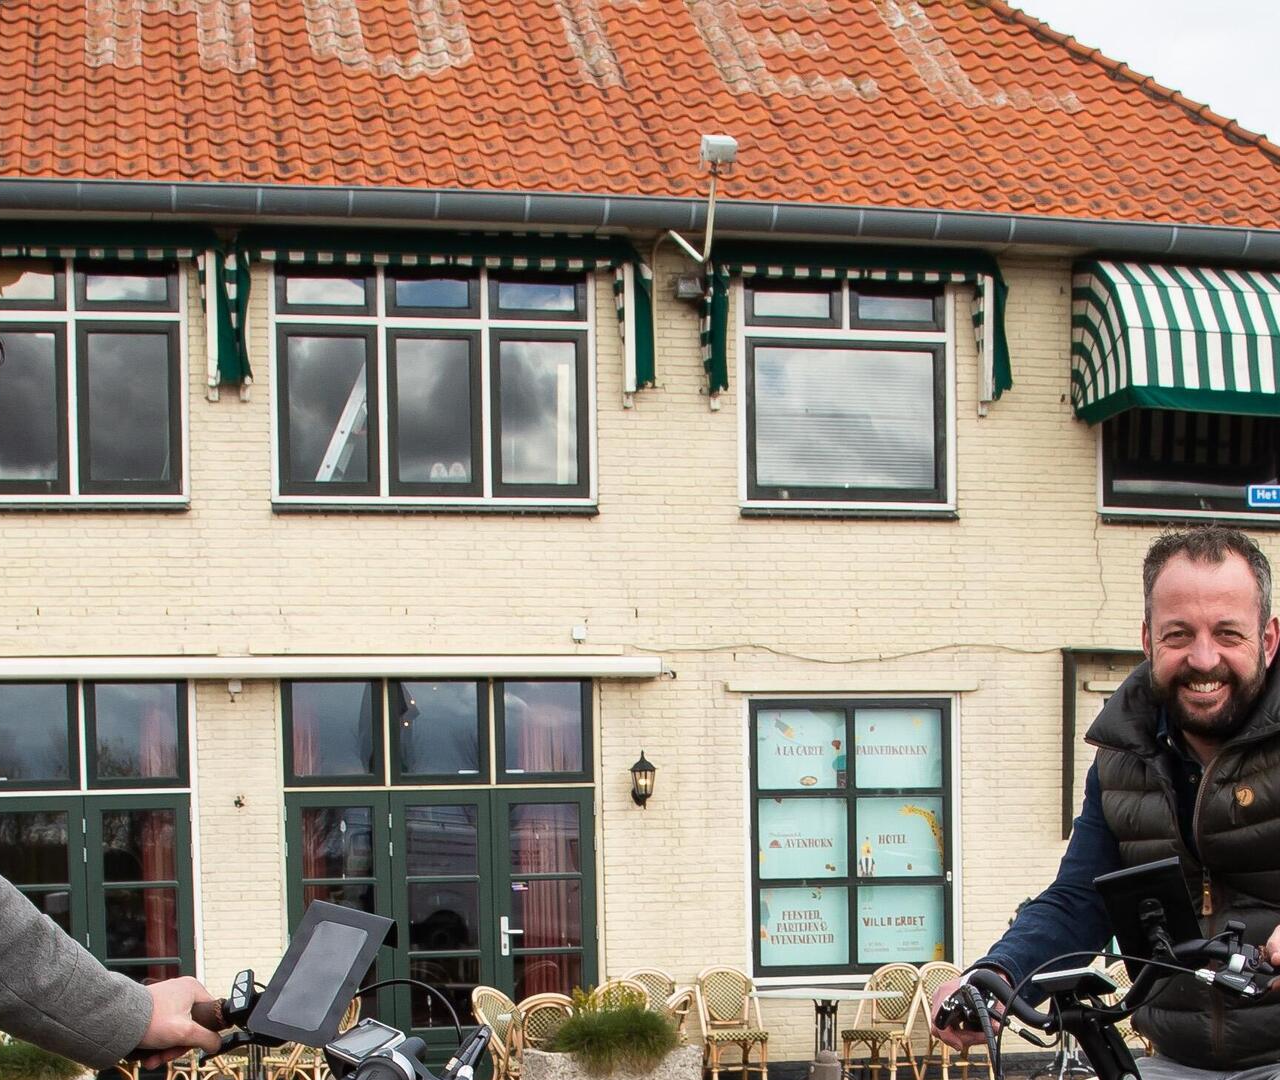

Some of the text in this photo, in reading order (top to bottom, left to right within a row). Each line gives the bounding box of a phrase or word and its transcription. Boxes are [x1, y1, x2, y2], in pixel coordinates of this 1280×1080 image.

[1256, 489, 1276, 500] Het
[796, 745, 824, 756] CARTE
[784, 838, 833, 848] AVENHORN
[878, 834, 907, 845] HOTEL
[863, 915, 925, 926] VILLA GROET
[770, 933, 834, 945] EVENEMENTEN
